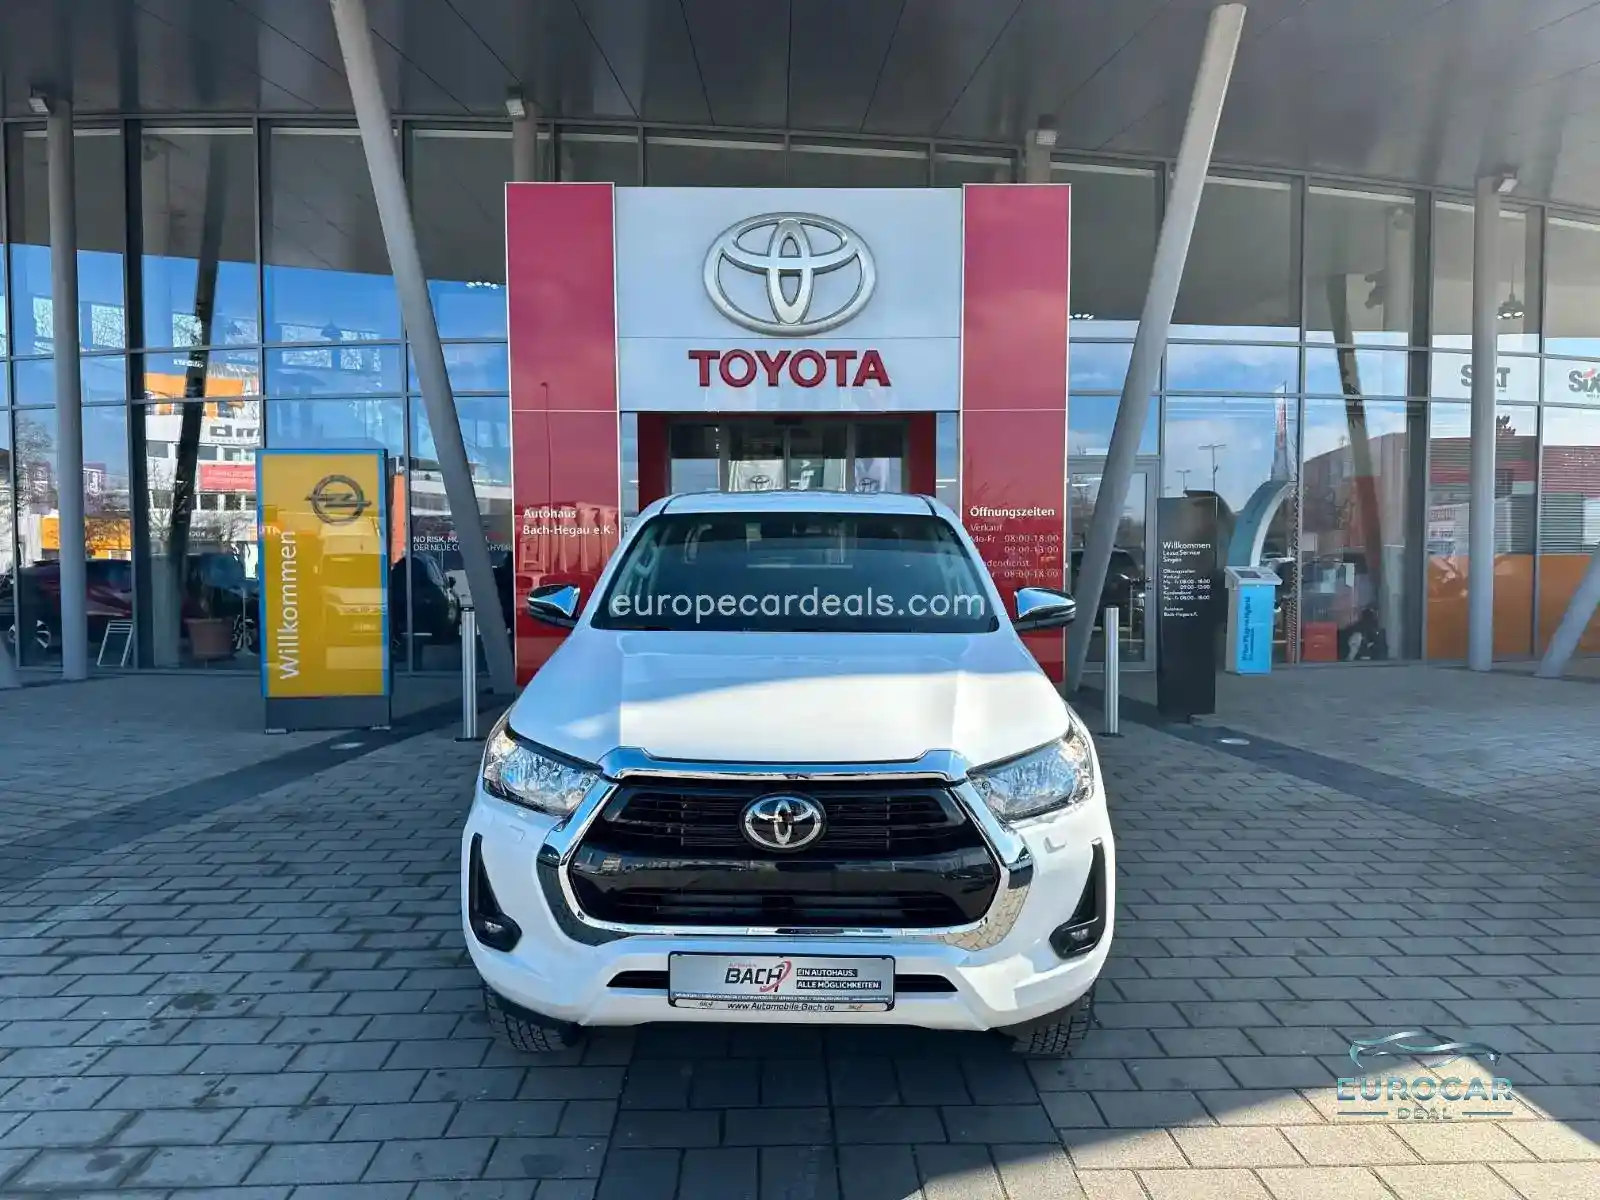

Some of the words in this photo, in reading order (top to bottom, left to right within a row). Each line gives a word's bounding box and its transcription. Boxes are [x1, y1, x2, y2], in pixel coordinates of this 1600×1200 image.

[688, 349, 892, 388] TOYOTA
[523, 508, 577, 519] Autohaus
[969, 505, 1056, 519] Öffnungszeiten
[523, 525, 590, 537] Bach-Hegau
[970, 523, 1003, 532] Verkauf
[1163, 541, 1211, 549] Willkommen
[277, 530, 301, 680] Willkommen
[811, 969, 857, 977] AUTOHAUS.
[725, 967, 783, 992] BACH
[818, 981, 880, 989] MÖGLICHKEITEN.
